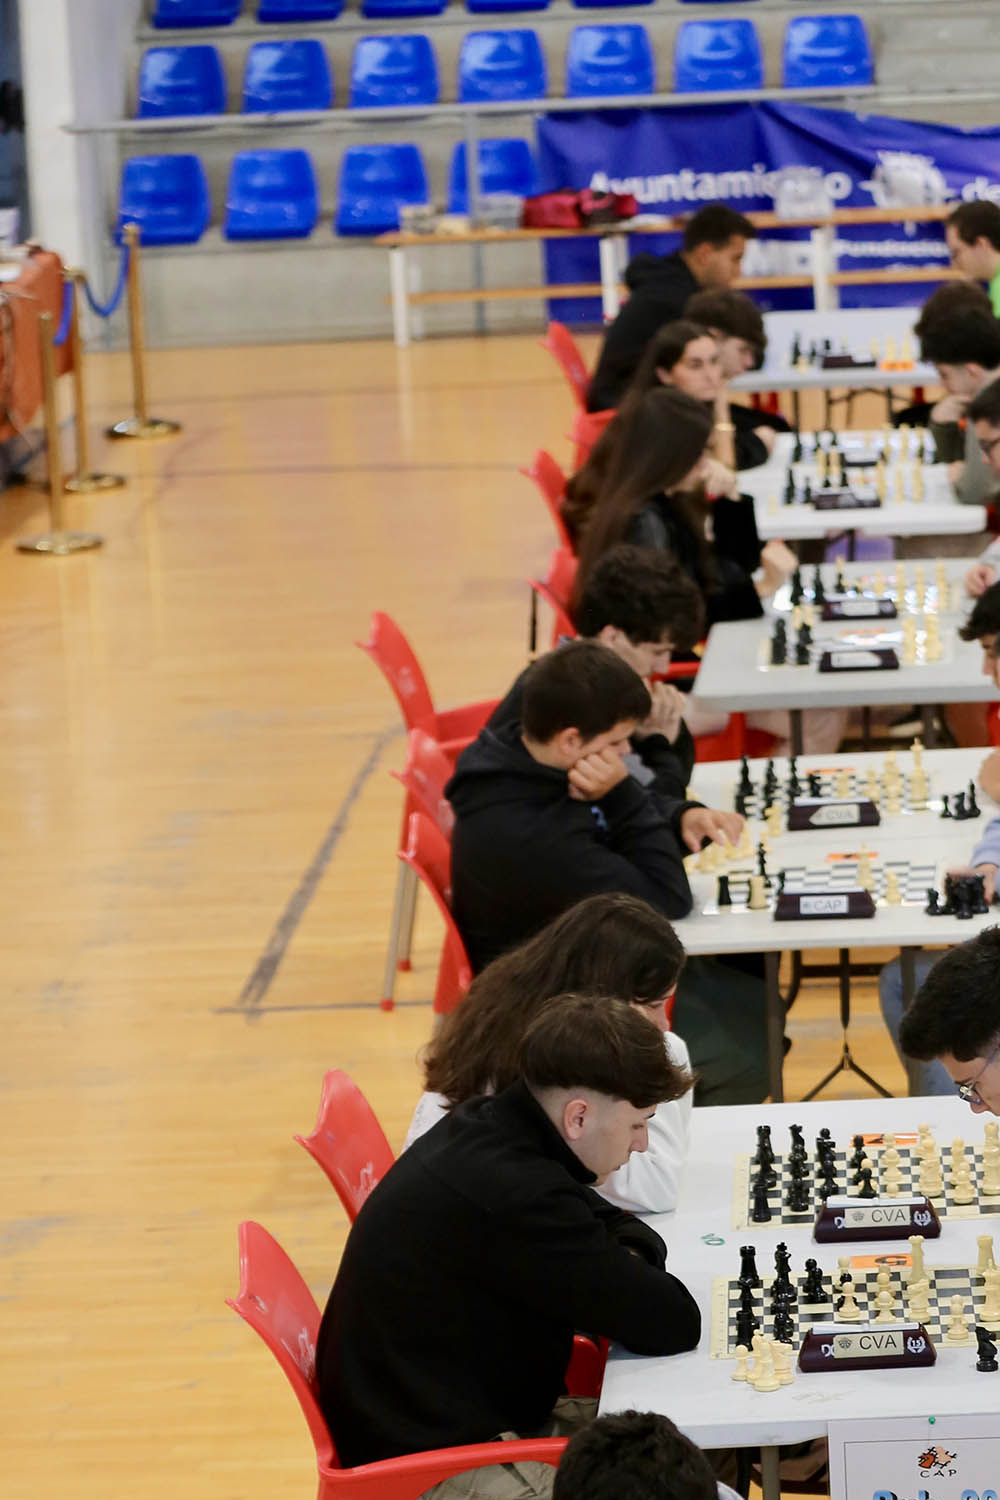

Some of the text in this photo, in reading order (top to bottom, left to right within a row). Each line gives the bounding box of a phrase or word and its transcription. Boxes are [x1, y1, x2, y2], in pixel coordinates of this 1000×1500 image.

[871, 1208, 906, 1223] CVA
[859, 1333, 898, 1351] CVA
[920, 1469, 957, 1478] CAP
